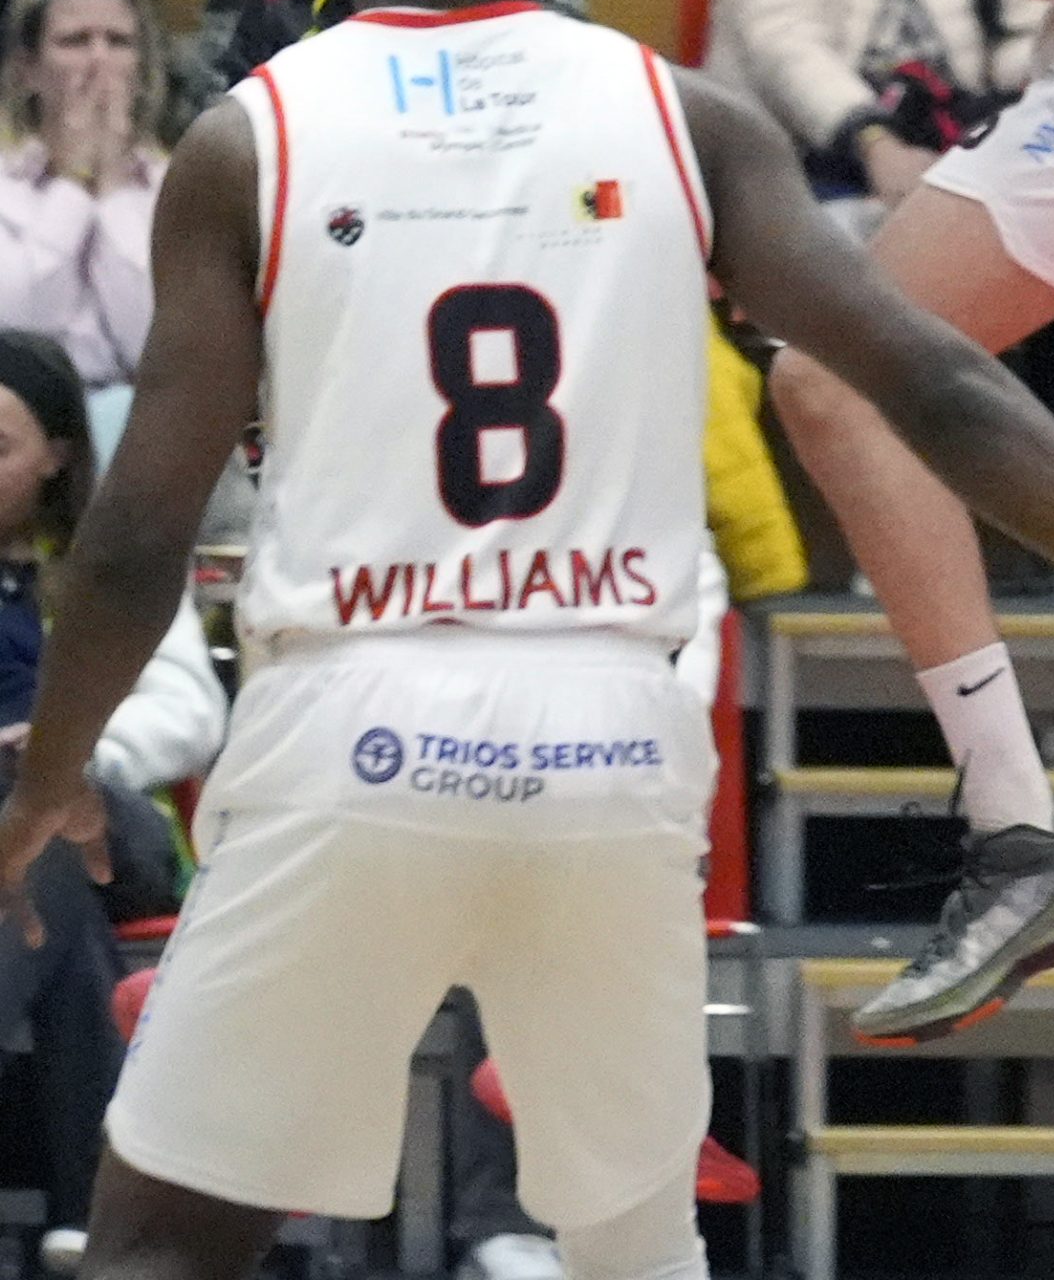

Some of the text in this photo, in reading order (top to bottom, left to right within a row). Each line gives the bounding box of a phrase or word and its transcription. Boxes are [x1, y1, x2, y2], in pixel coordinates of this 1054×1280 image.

[427, 282, 567, 528] 8
[330, 547, 657, 626] WILLIAMS
[416, 731, 663, 771] TRIOS SERVICE
[409, 767, 545, 803] GROUP
